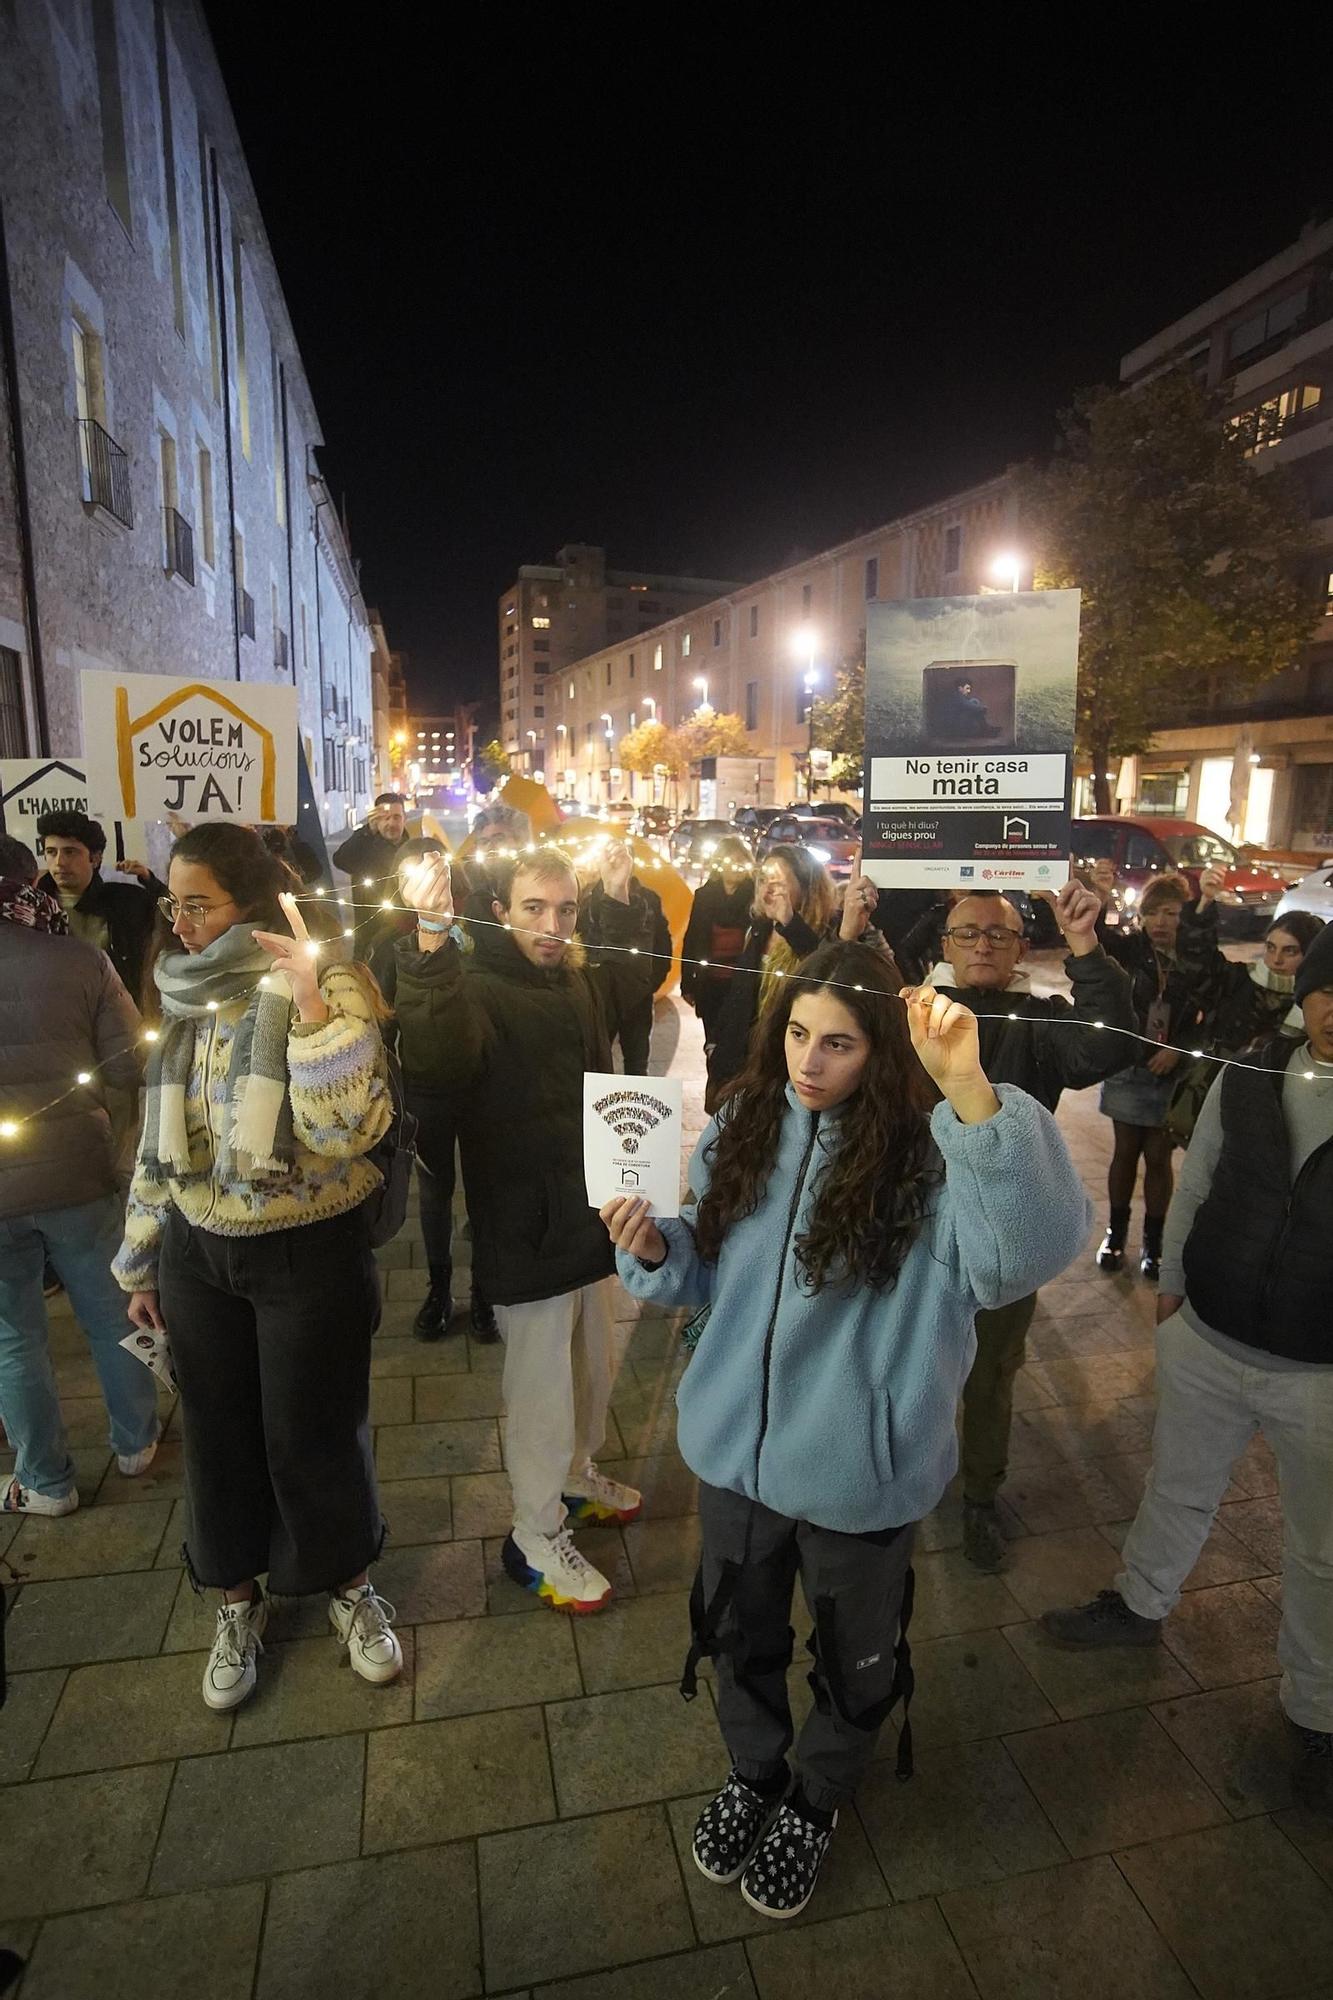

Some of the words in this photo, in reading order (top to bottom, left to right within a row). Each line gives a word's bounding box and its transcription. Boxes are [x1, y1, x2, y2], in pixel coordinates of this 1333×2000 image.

[158, 718, 243, 748] VOLEM
[139, 742, 256, 771] Solucions
[906, 760, 930, 774] No
[937, 759, 979, 774] tenir
[985, 760, 1028, 773] casa
[163, 773, 243, 813] JA!
[932, 775, 999, 795] mata
[908, 821, 916, 829] hi
[918, 821, 939, 829] dius?
[882, 831, 912, 841] digues
[914, 832, 936, 841] prou
